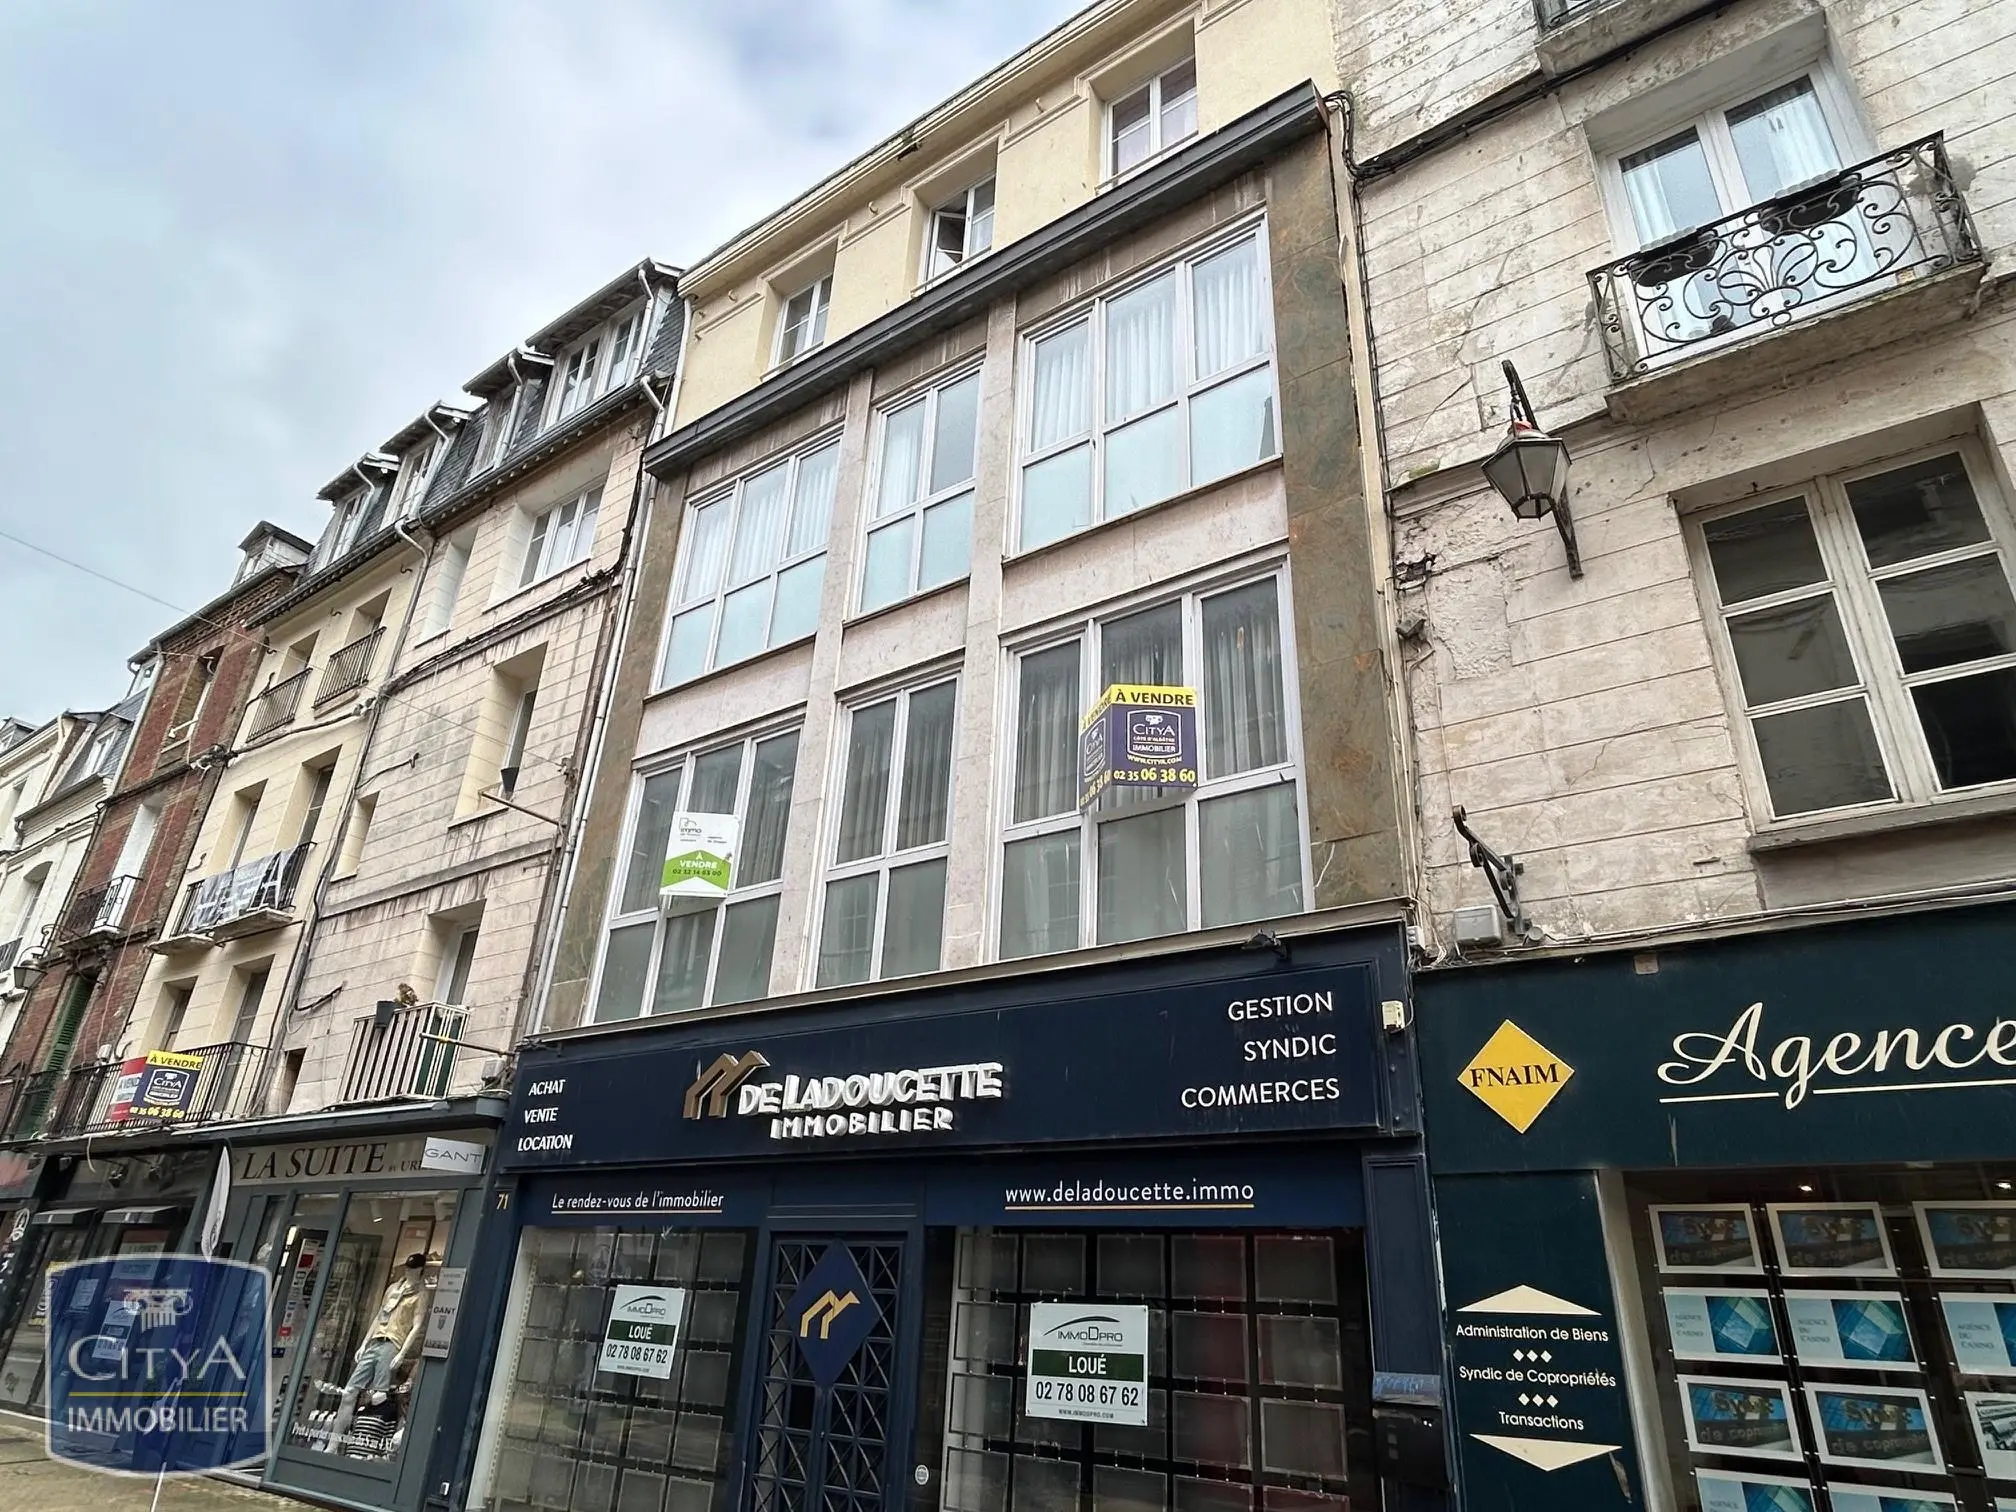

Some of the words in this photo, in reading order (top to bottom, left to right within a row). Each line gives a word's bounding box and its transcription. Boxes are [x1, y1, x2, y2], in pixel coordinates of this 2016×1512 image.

[1116, 688, 1126, 703] À
[1131, 692, 1194, 705] VENDRE
[1132, 723, 1176, 736] CITYA
[1132, 744, 1176, 753] IMMOBILIER
[1113, 770, 1126, 780] 02
[1127, 771, 1139, 781] 35
[1140, 767, 1157, 781] 06
[1160, 768, 1176, 783] 38
[1179, 769, 1196, 783] 60
[680, 860, 719, 869] VENDRE
[1228, 991, 1333, 1021] GESTION
[1244, 1034, 1337, 1062] SYNDIC
[1657, 1002, 2016, 1110] Agence
[161, 1057, 202, 1069] VENDRE
[1469, 1063, 1560, 1087] FNAIM
[528, 1079, 566, 1096] ACHAT
[1181, 1078, 1340, 1108] COMMERCES
[147, 1106, 160, 1117] 06
[159, 1108, 172, 1118] 38
[172, 1109, 185, 1119] 60
[524, 1107, 559, 1124] VENTE
[770, 1106, 954, 1140] IMMOBILIER
[517, 1134, 573, 1152] LOCATION
[240, 1152, 277, 1180] LA
[285, 1142, 389, 1179] SUITE
[425, 1148, 482, 1164] GANT
[1005, 1177, 1255, 1202] www.deladoucette.immo
[496, 1193, 509, 1210] 71
[552, 1193, 564, 1208] Le
[567, 1192, 632, 1208] rendez-vous
[635, 1191, 649, 1208] de
[652, 1190, 724, 1208] l'immobilier
[433, 1306, 456, 1314] GANT
[628, 1324, 653, 1340] LOUÉ
[1456, 1325, 1547, 1340] Administration
[1550, 1328, 1569, 1340] de
[1572, 1328, 1609, 1342] Biens
[606, 1344, 618, 1358] 02
[618, 1345, 629, 1360] 78
[631, 1346, 642, 1361] 08
[643, 1348, 655, 1363] 67
[656, 1349, 668, 1364] 62
[1068, 1353, 1107, 1375] LOUÉ
[1459, 1366, 1502, 1382] Syndic
[1505, 1369, 1524, 1381] de
[1527, 1369, 1617, 1387] Copropriétés
[1036, 1381, 1052, 1400] 02
[1057, 1383, 1074, 1401] 78
[1078, 1384, 1095, 1403] 08
[1100, 1386, 1117, 1405] 67
[1121, 1387, 1139, 1407] 62
[1499, 1411, 1584, 1430] Transactions
